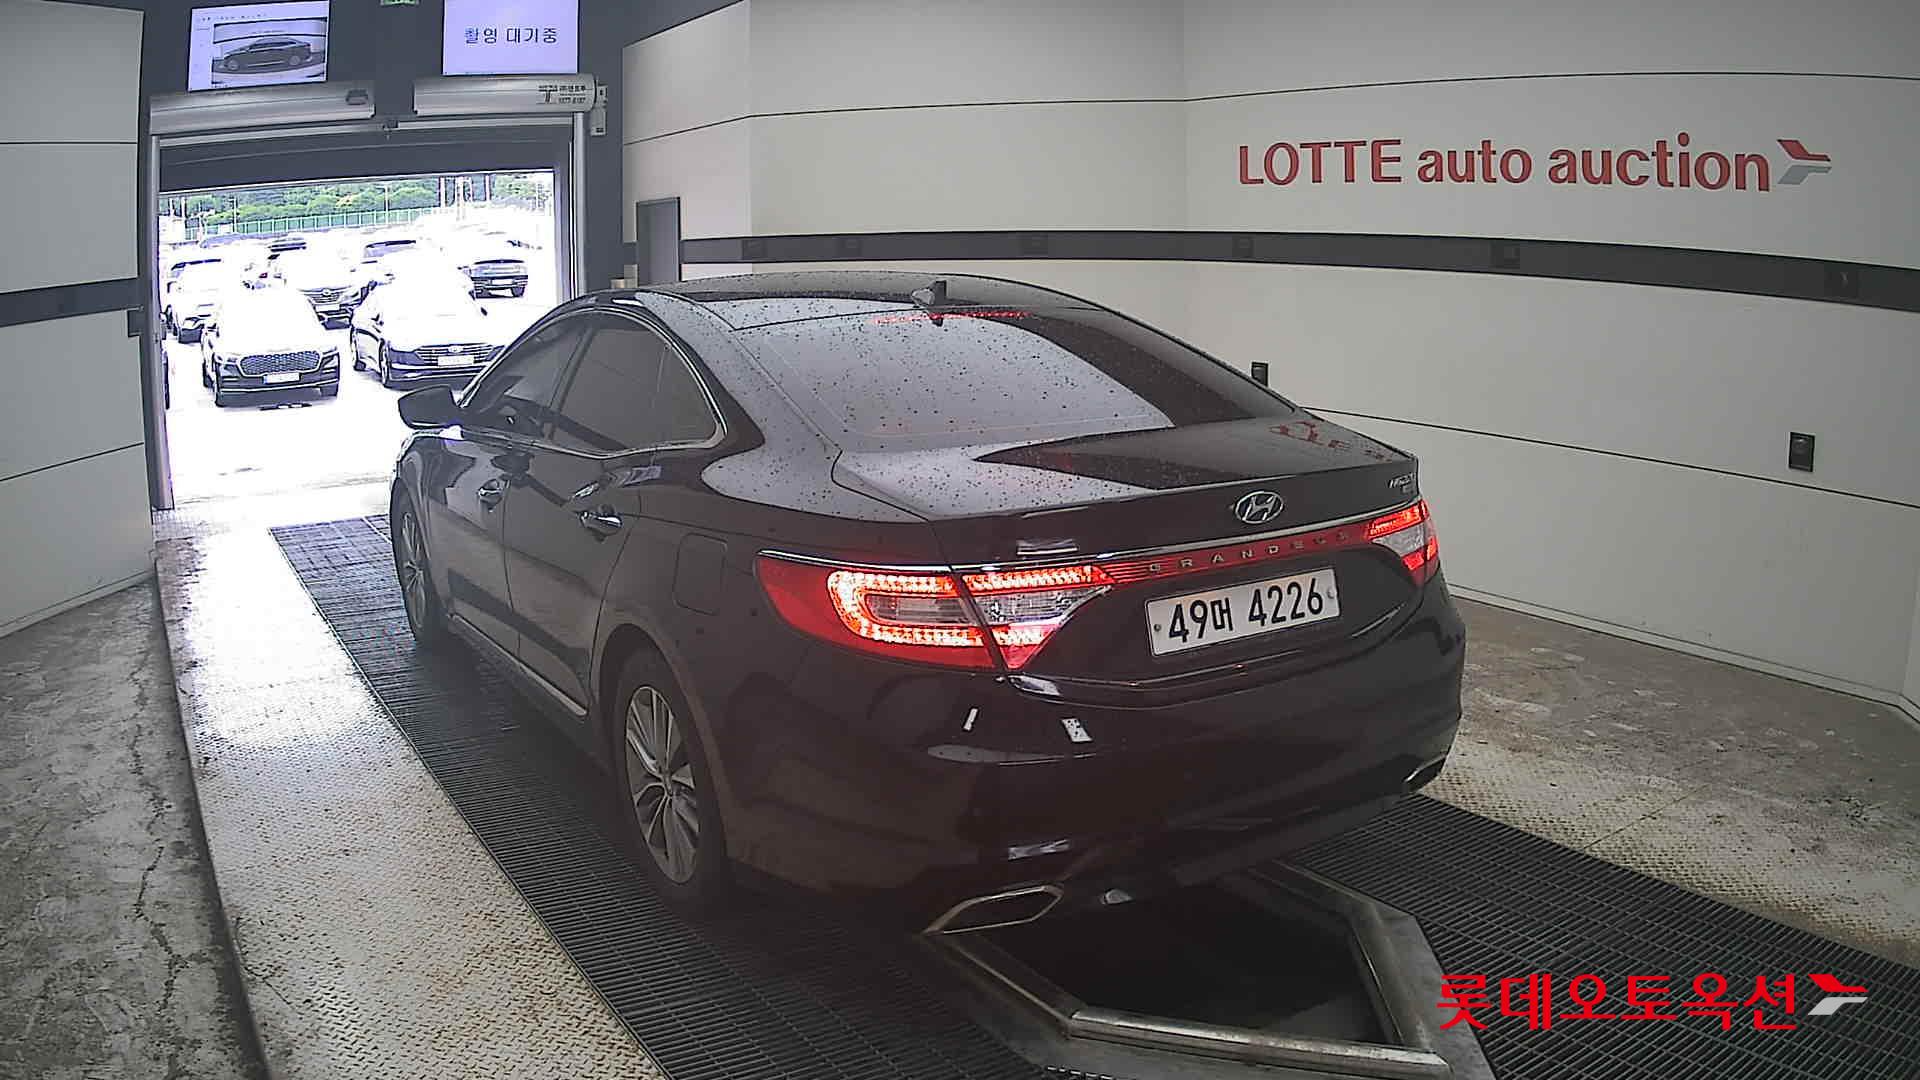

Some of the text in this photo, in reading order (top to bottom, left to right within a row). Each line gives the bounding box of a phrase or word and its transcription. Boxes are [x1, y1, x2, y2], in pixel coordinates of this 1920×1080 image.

[506, 27, 557, 44] 대기중
[1240, 132, 1770, 192] LOTTE auto auction
[1168, 578, 1325, 644] 49머 4226
